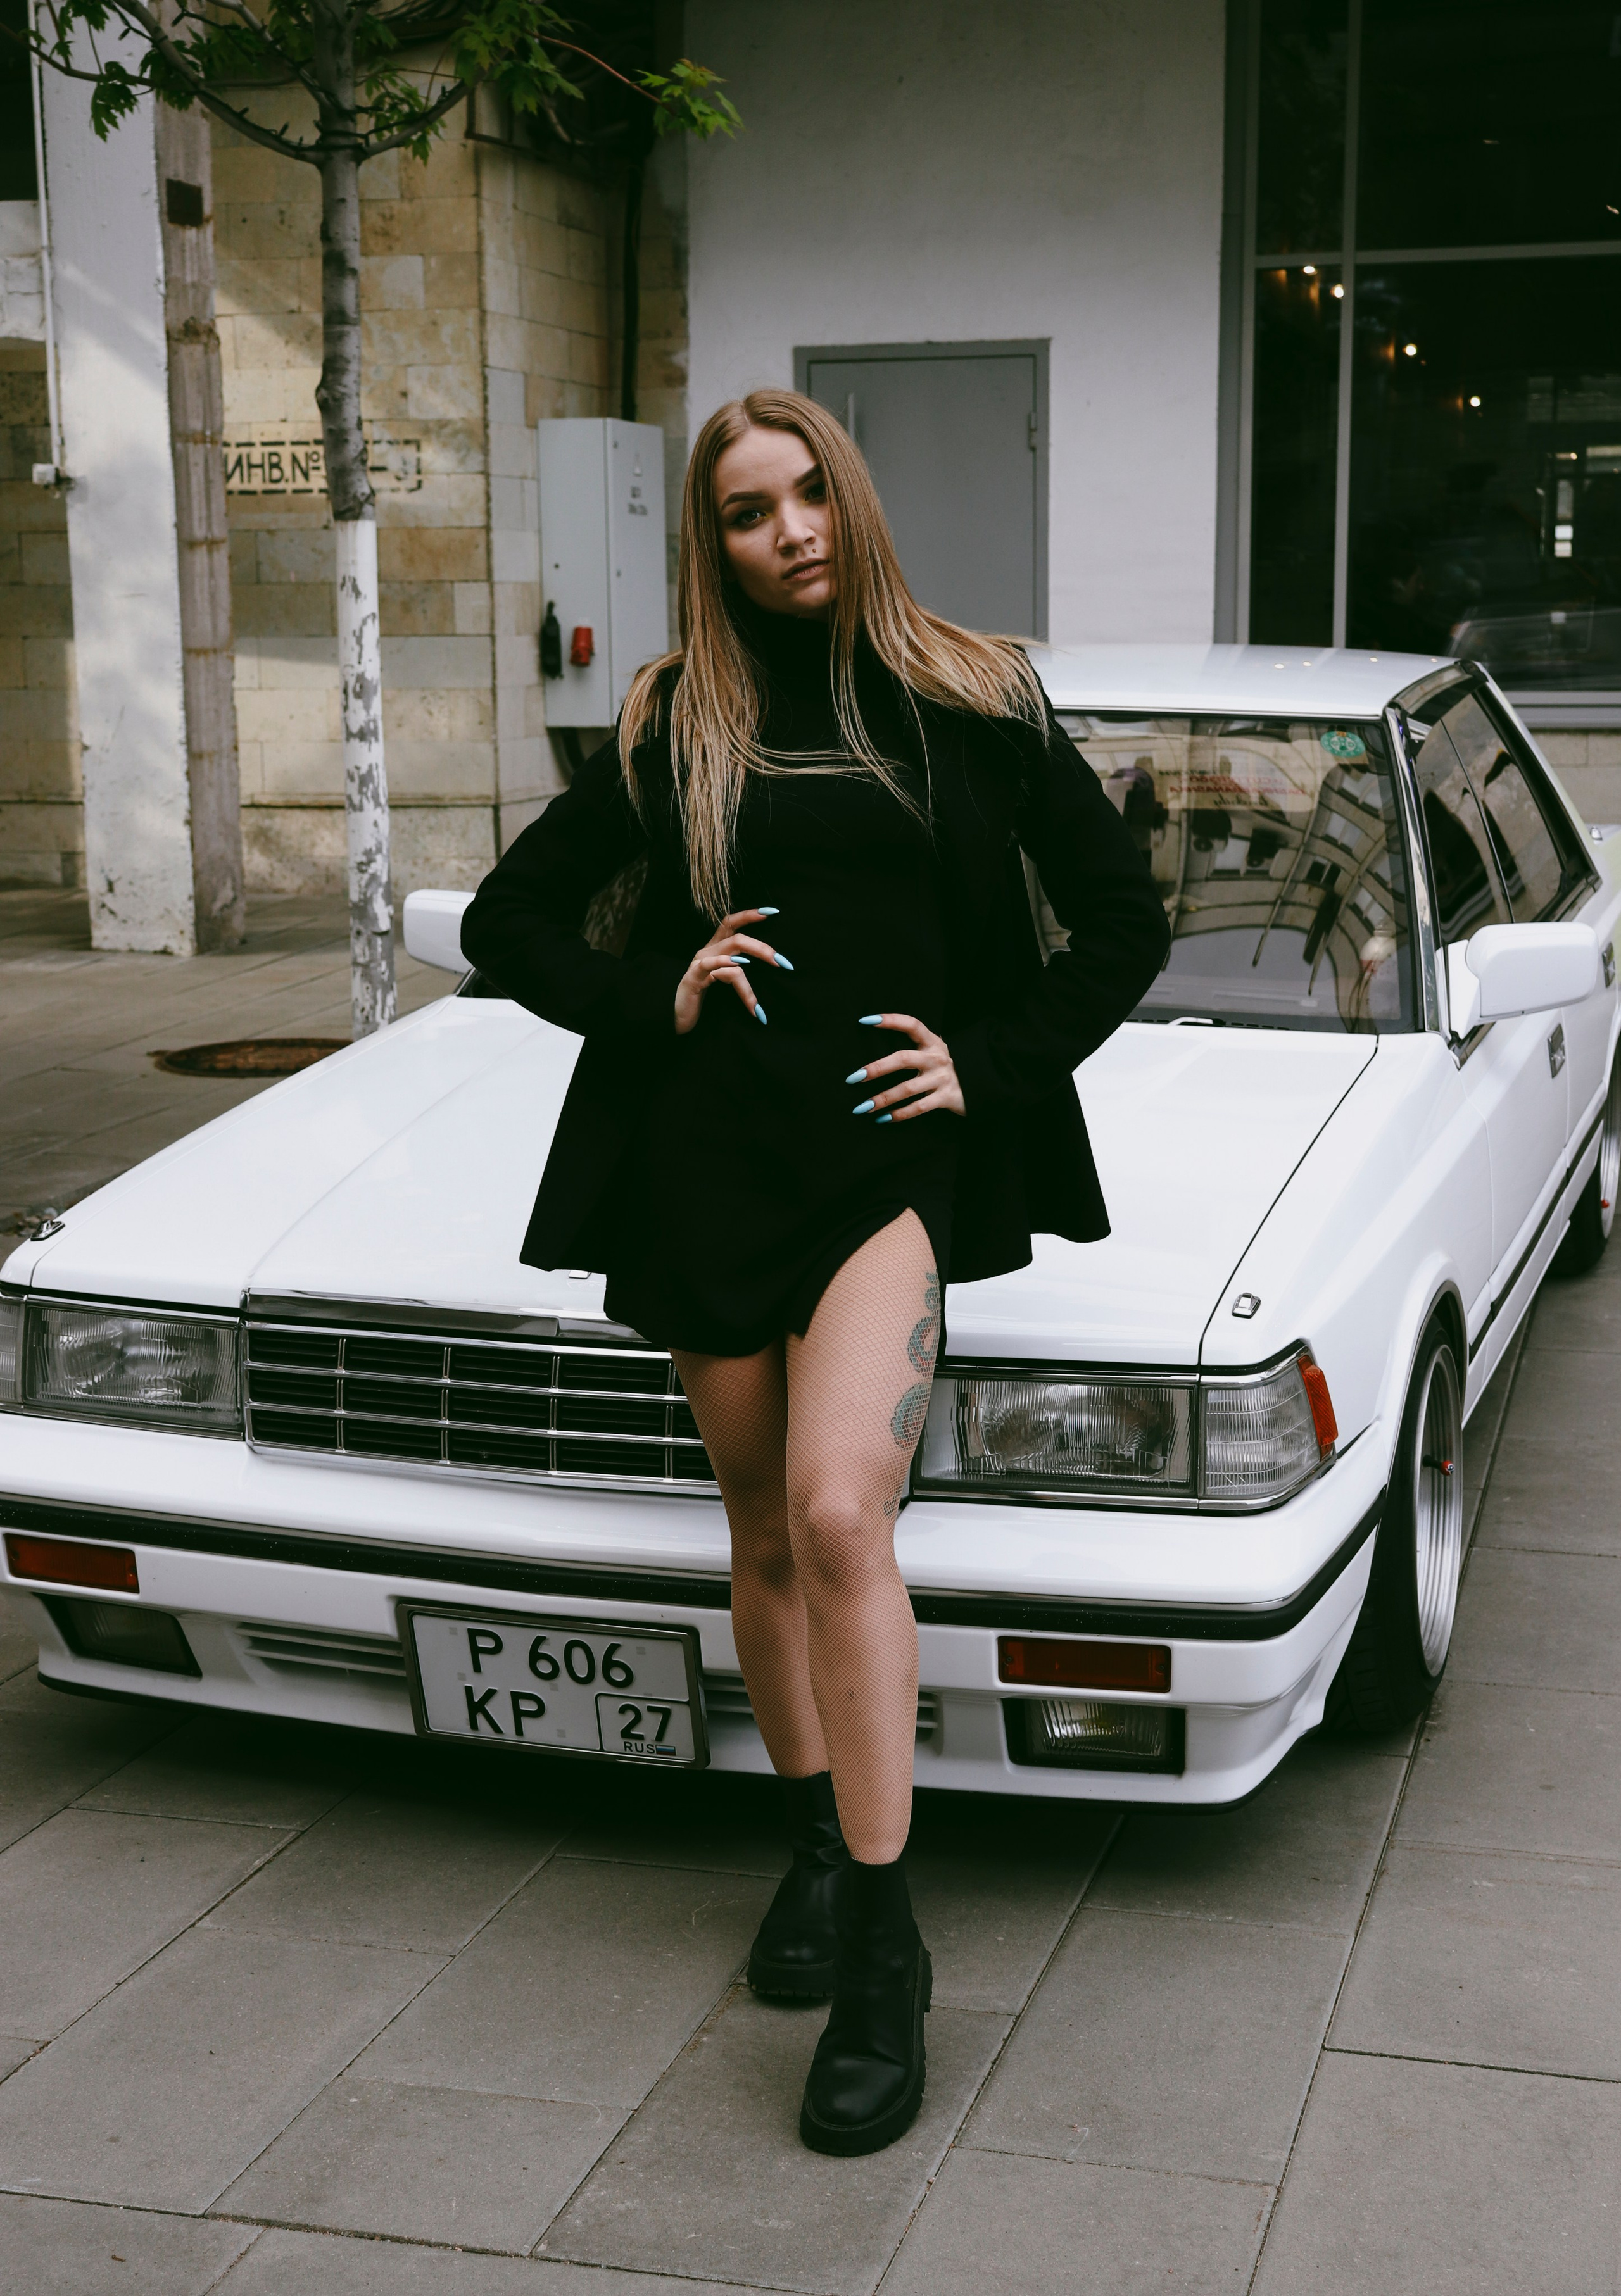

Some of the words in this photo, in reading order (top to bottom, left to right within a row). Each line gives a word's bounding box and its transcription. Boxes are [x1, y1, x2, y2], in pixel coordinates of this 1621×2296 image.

[528, 1635, 634, 1689] 606
[618, 1702, 672, 1742] 27
[623, 1741, 655, 1754] RUS
